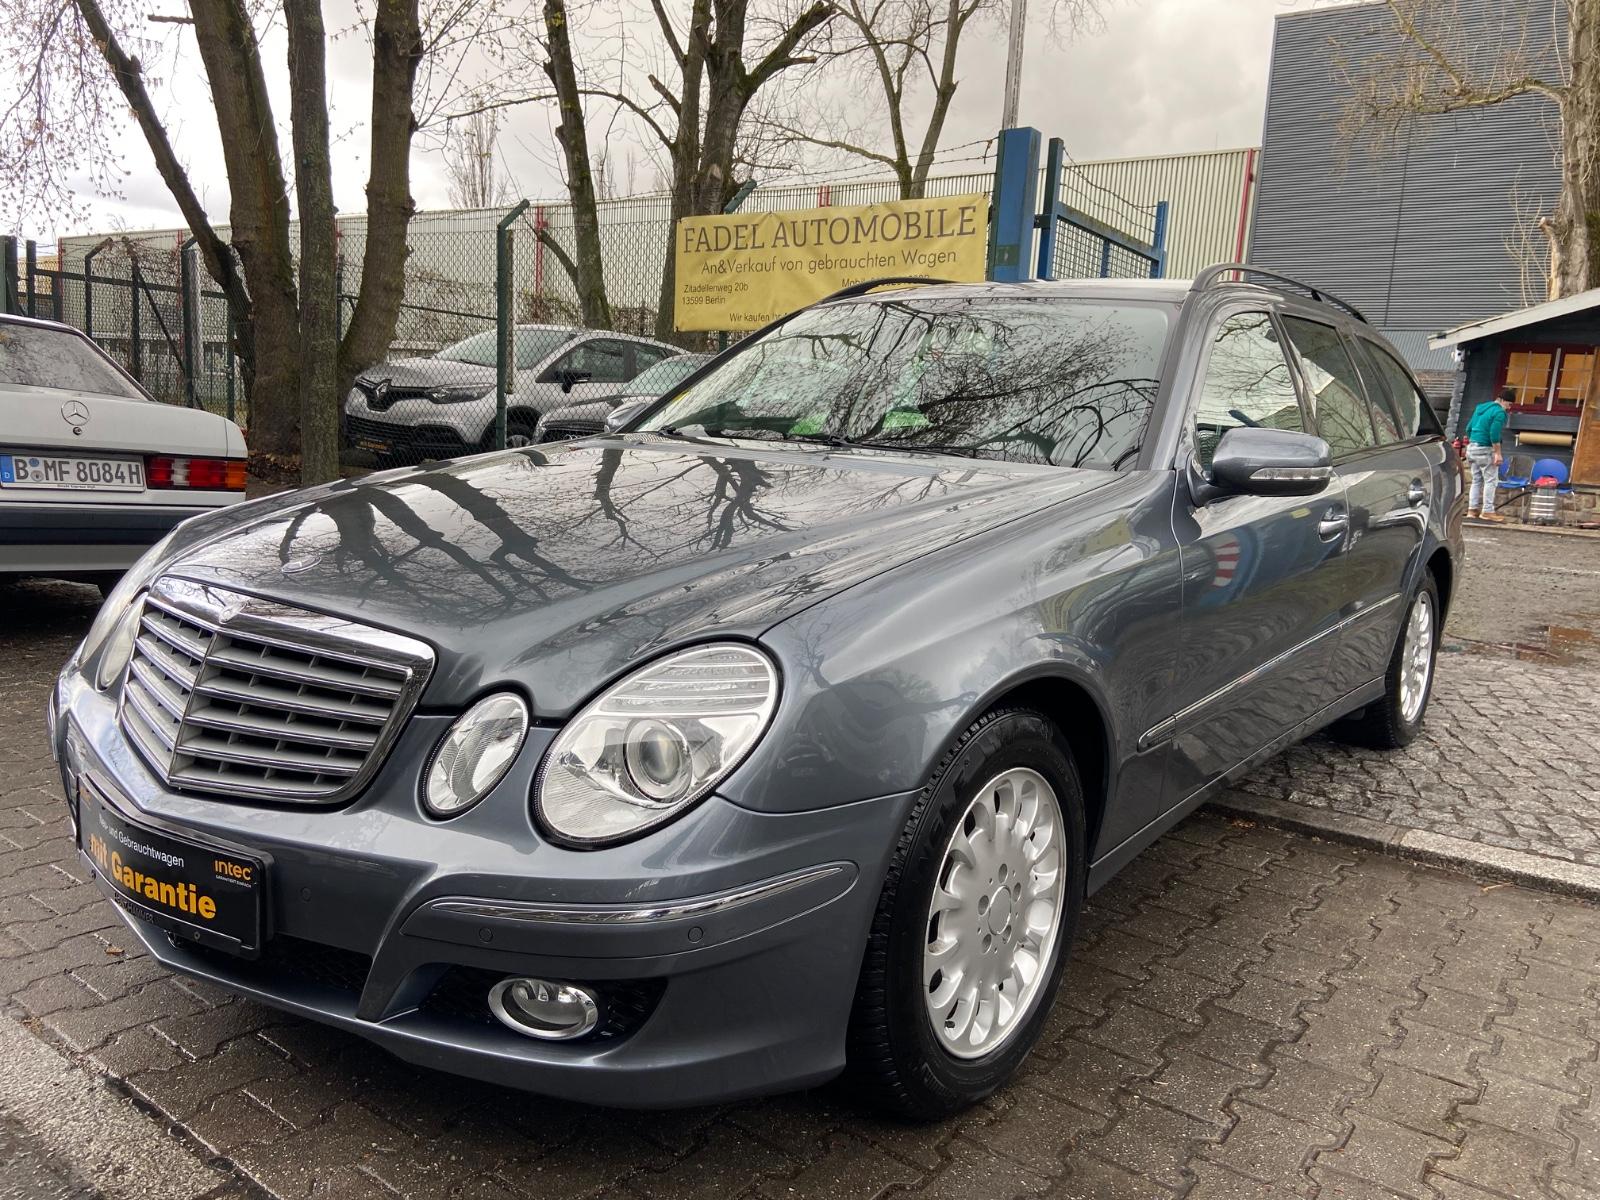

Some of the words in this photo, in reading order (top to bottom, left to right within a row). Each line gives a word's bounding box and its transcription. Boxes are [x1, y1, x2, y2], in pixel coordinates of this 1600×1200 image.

[683, 223, 765, 253] FADEL
[770, 205, 977, 249] AUTOMOBILE
[701, 256, 777, 275] An&Verkauf
[780, 259, 803, 271] von
[808, 251, 896, 274] gebrauchten
[901, 248, 957, 268] Wagen
[682, 296, 704, 305] 13599
[705, 295, 726, 305] Berlin
[683, 282, 733, 294] Zitadellenweg
[734, 282, 749, 292] 20b
[729, 312, 742, 322] Wir
[743, 312, 770, 322] kaufen
[14, 459, 29, 480] B
[43, 460, 70, 481] MF
[76, 461, 141, 484] 8084H
[118, 830, 185, 868] Gebrauchtwagen
[111, 850, 217, 919] Garantie
